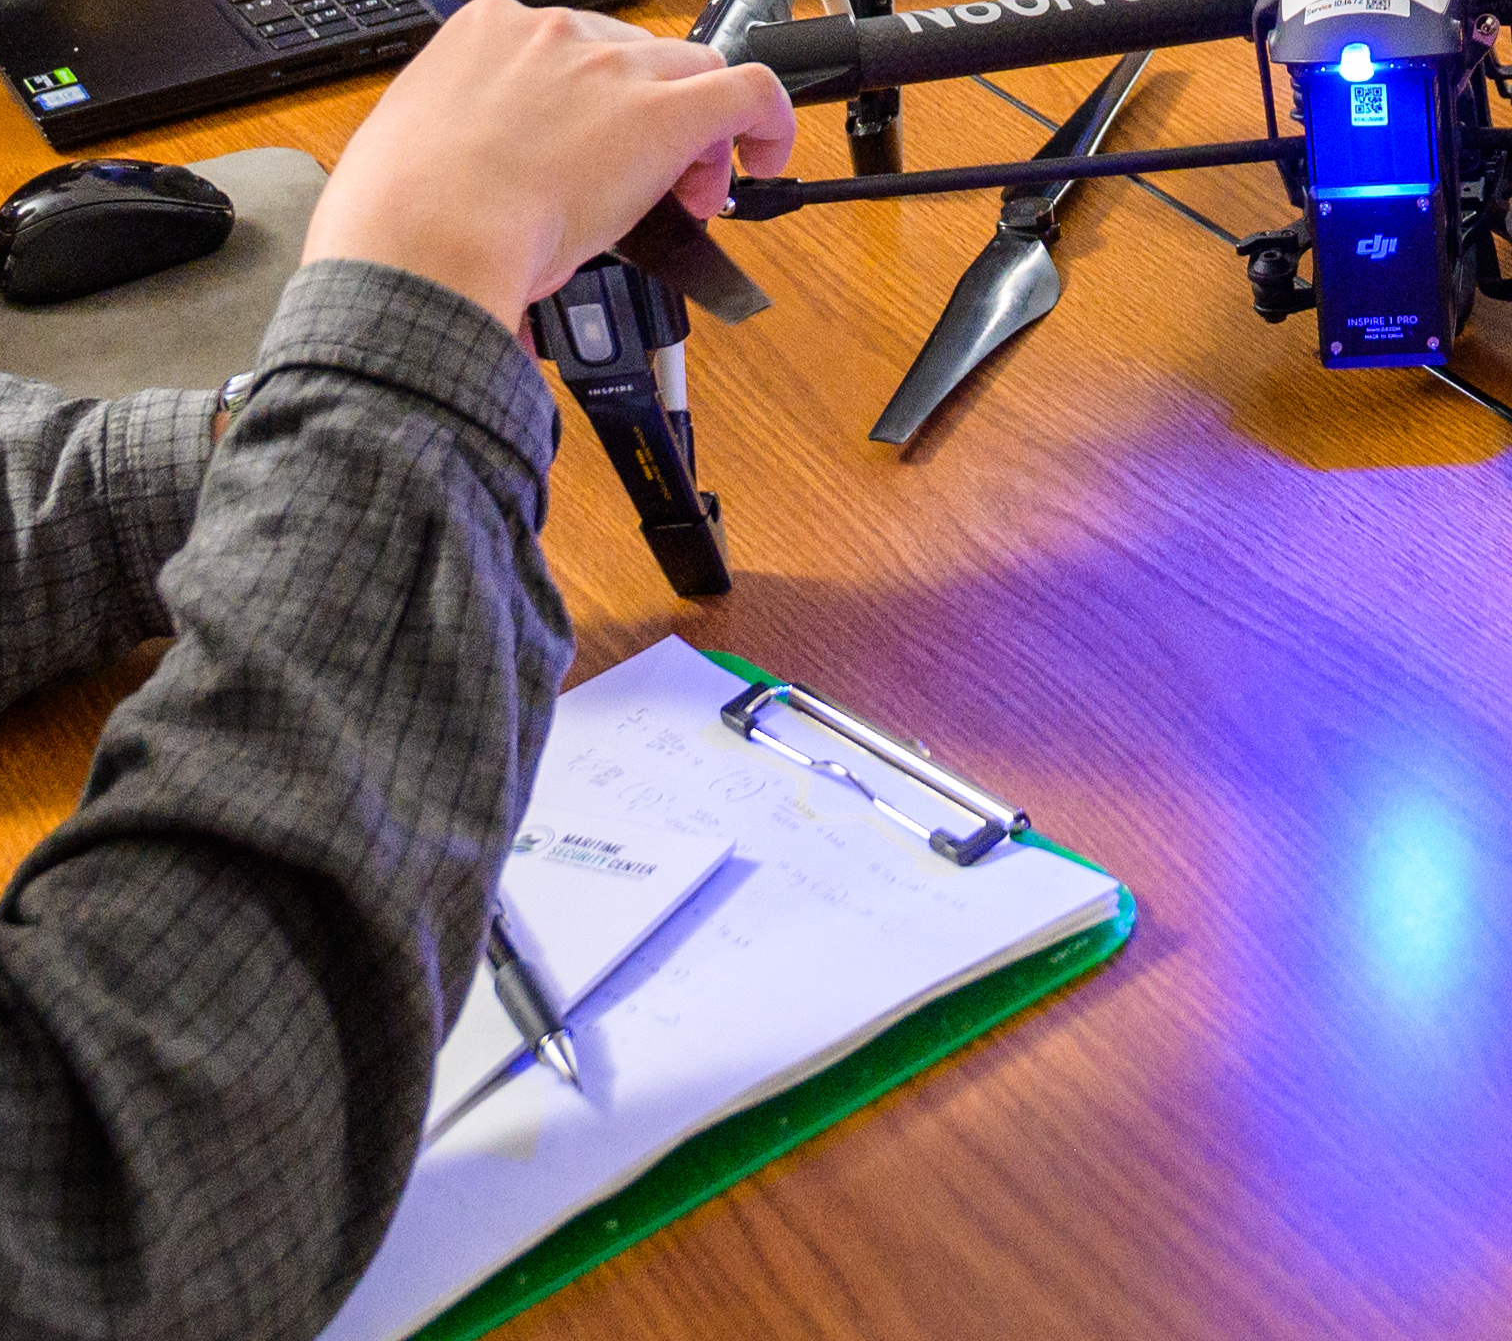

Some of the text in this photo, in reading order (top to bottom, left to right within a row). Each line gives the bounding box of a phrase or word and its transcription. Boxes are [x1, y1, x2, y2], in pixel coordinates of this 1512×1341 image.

[1347, 316, 1385, 326] INSPIRE
[1396, 315, 1418, 325] PRO
[561, 833, 625, 855] MARITIME
[548, 845, 658, 875] SECURITY CENTER
